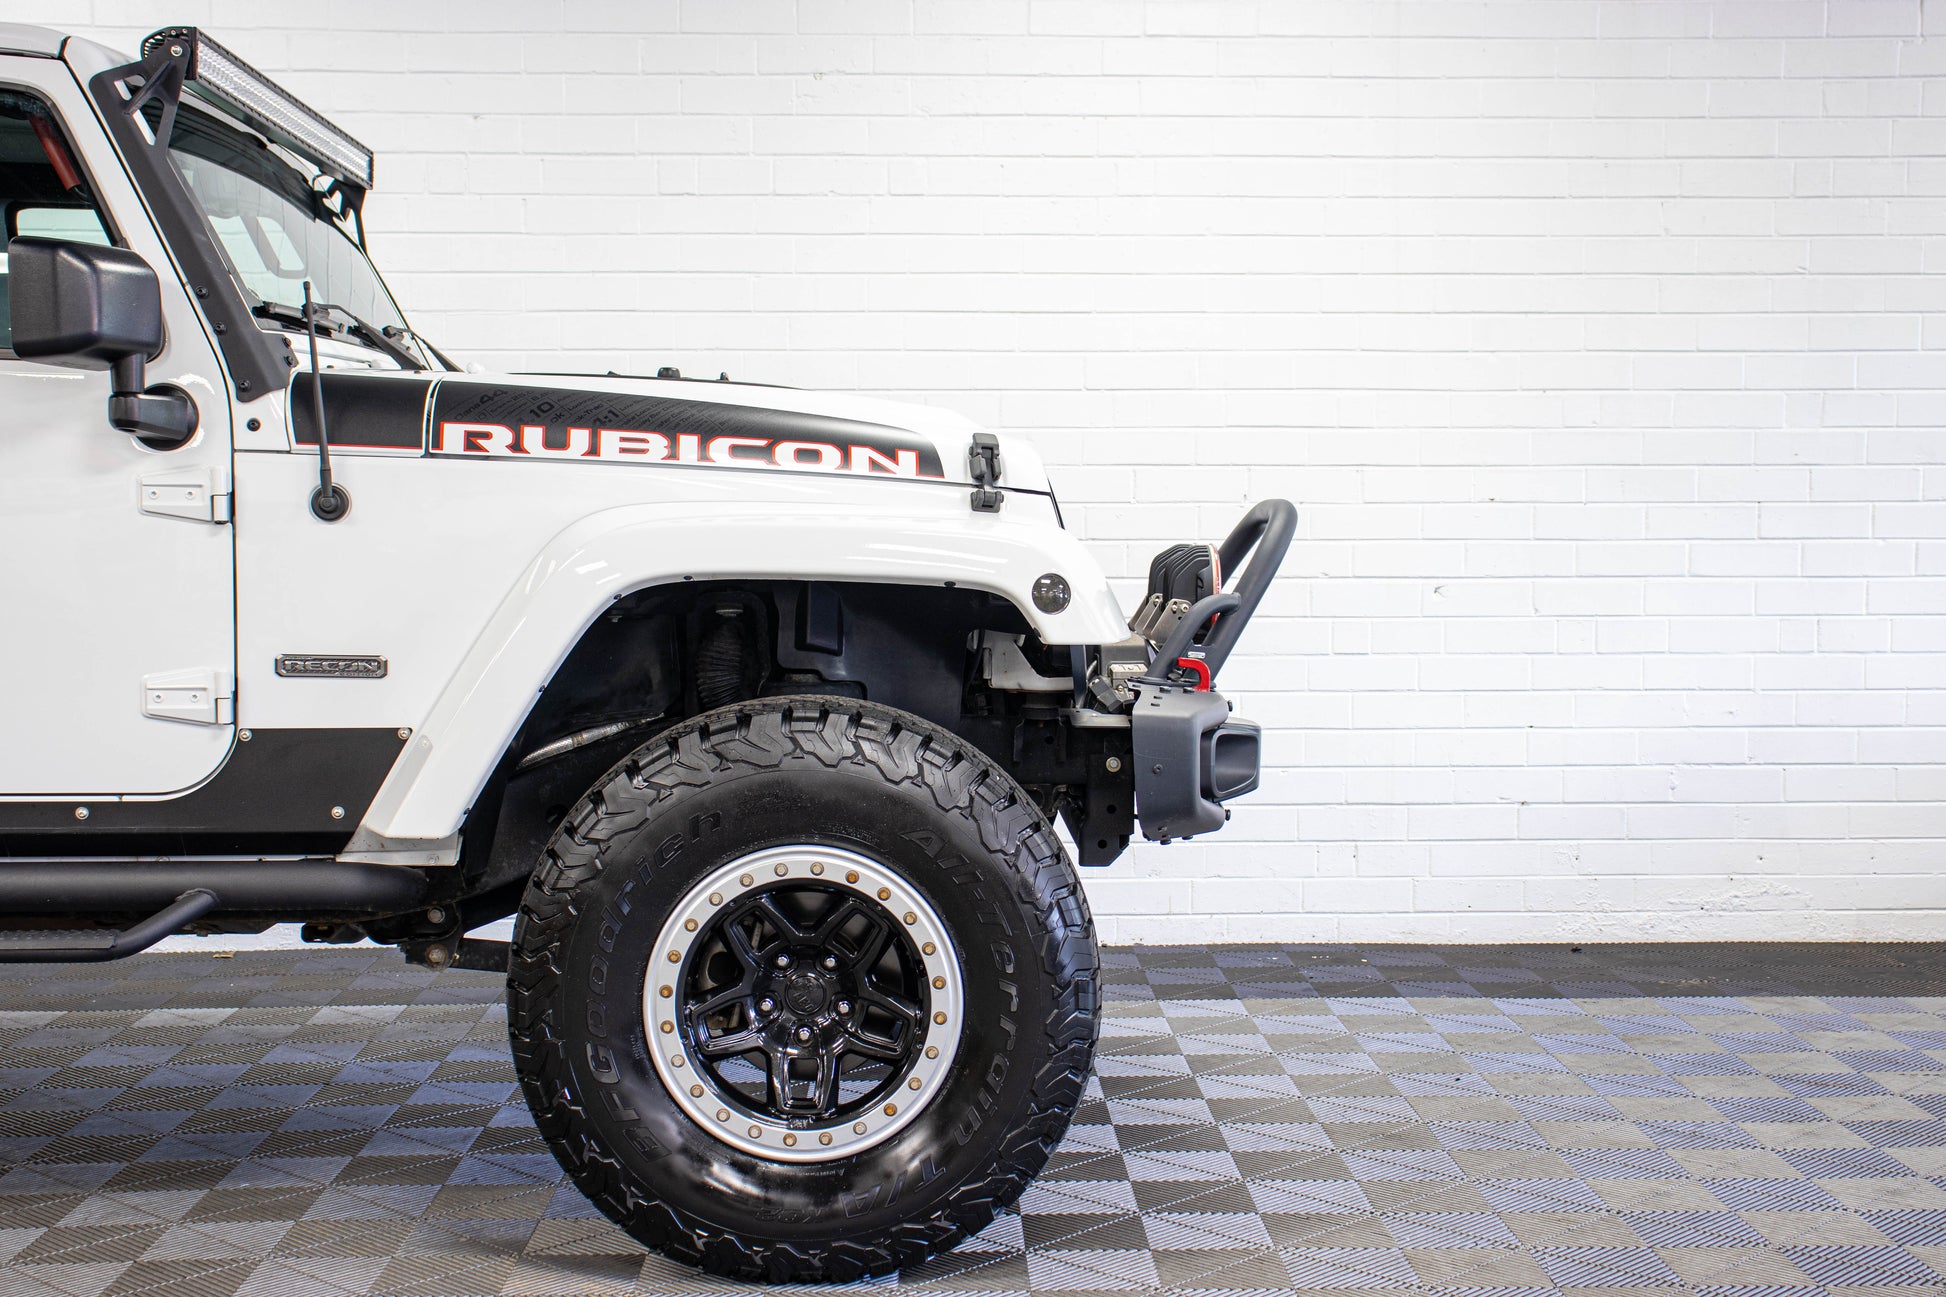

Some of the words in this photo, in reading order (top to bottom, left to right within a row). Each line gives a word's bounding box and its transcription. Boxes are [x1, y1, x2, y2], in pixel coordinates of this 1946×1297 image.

[438, 421, 922, 478] RUBICON
[283, 660, 379, 671] RECON
[585, 809, 723, 1163] BFGoodrich
[900, 826, 1020, 1147] All-Terrain
